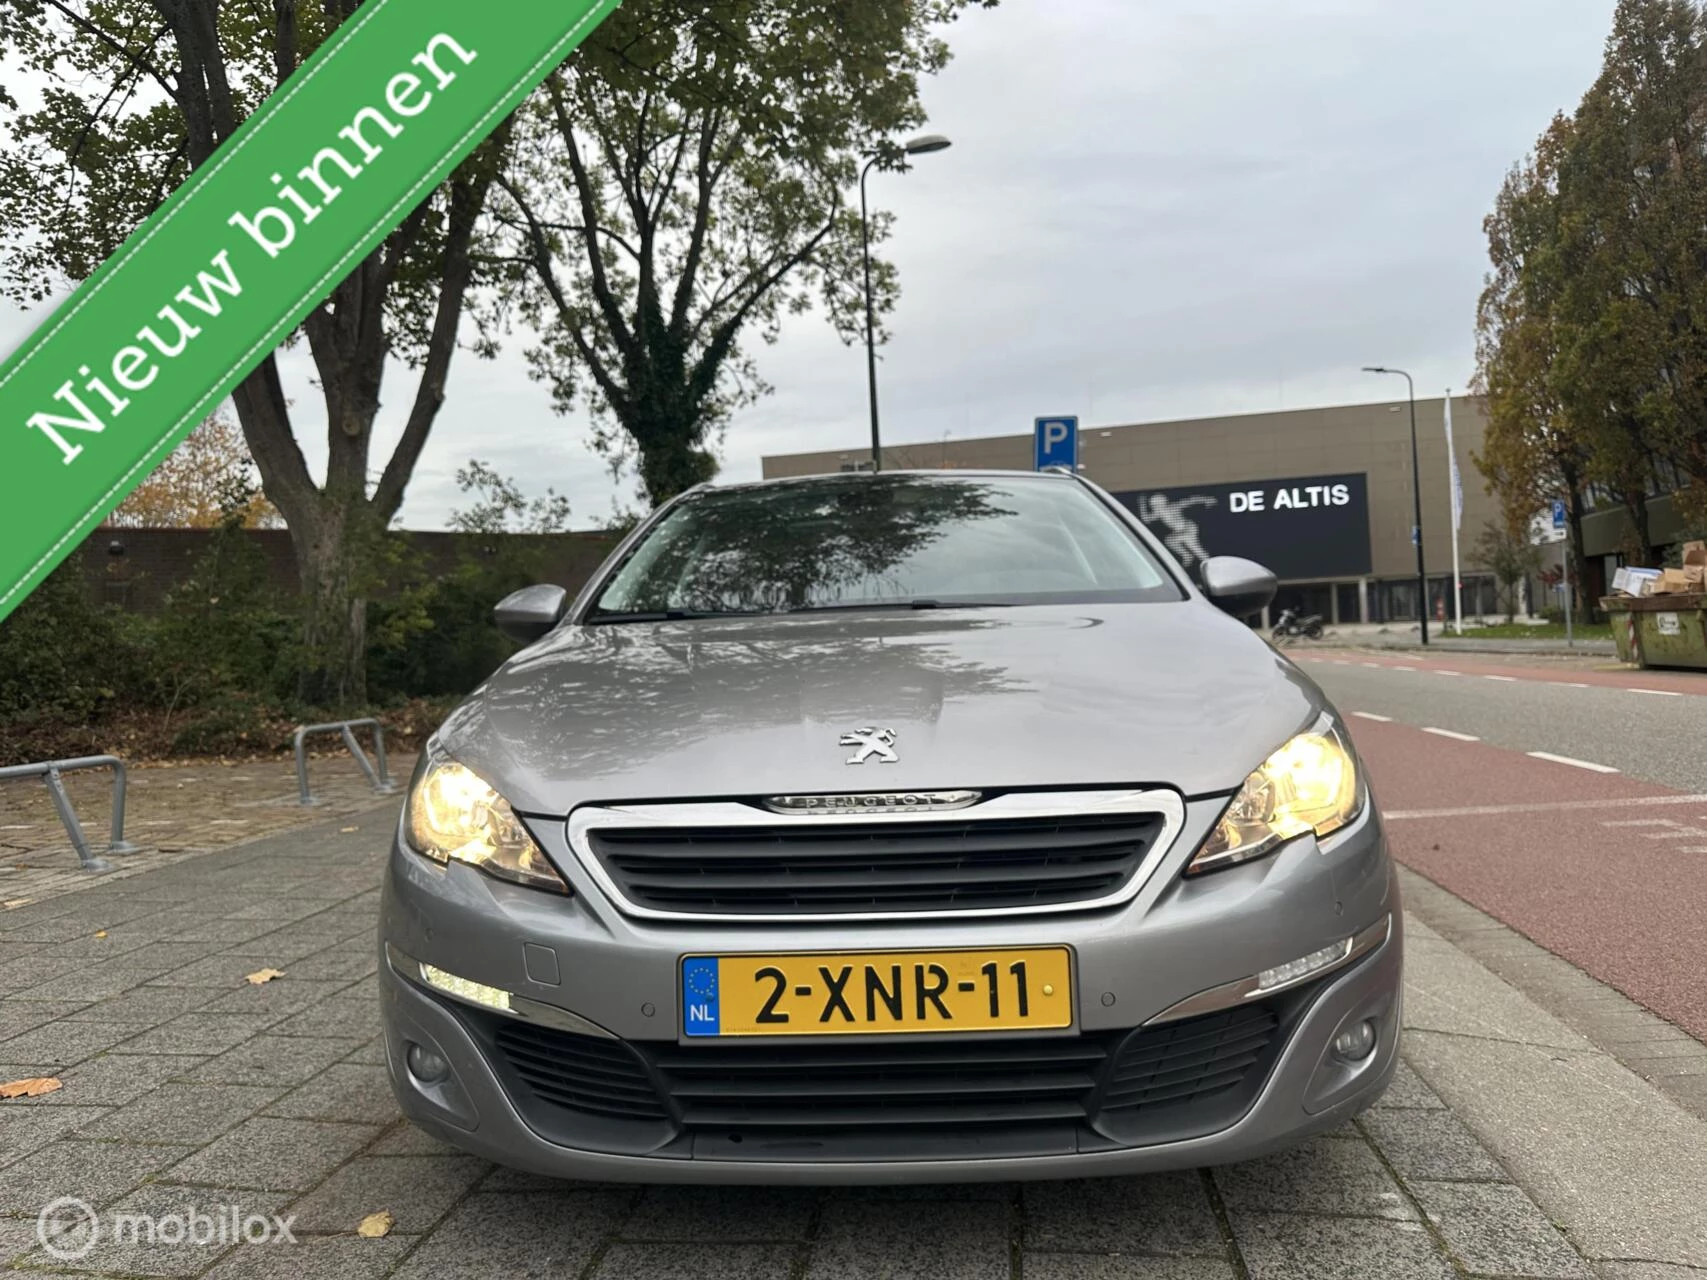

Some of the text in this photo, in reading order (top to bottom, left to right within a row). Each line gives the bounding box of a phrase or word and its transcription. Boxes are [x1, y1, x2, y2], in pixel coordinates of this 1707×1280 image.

[1044, 422, 1068, 454] P
[1229, 484, 1350, 513] DE ALTIS
[805, 794, 936, 809] PEUGEOT
[754, 961, 1029, 1023] 2-XNR-11
[690, 1004, 715, 1021] NL
